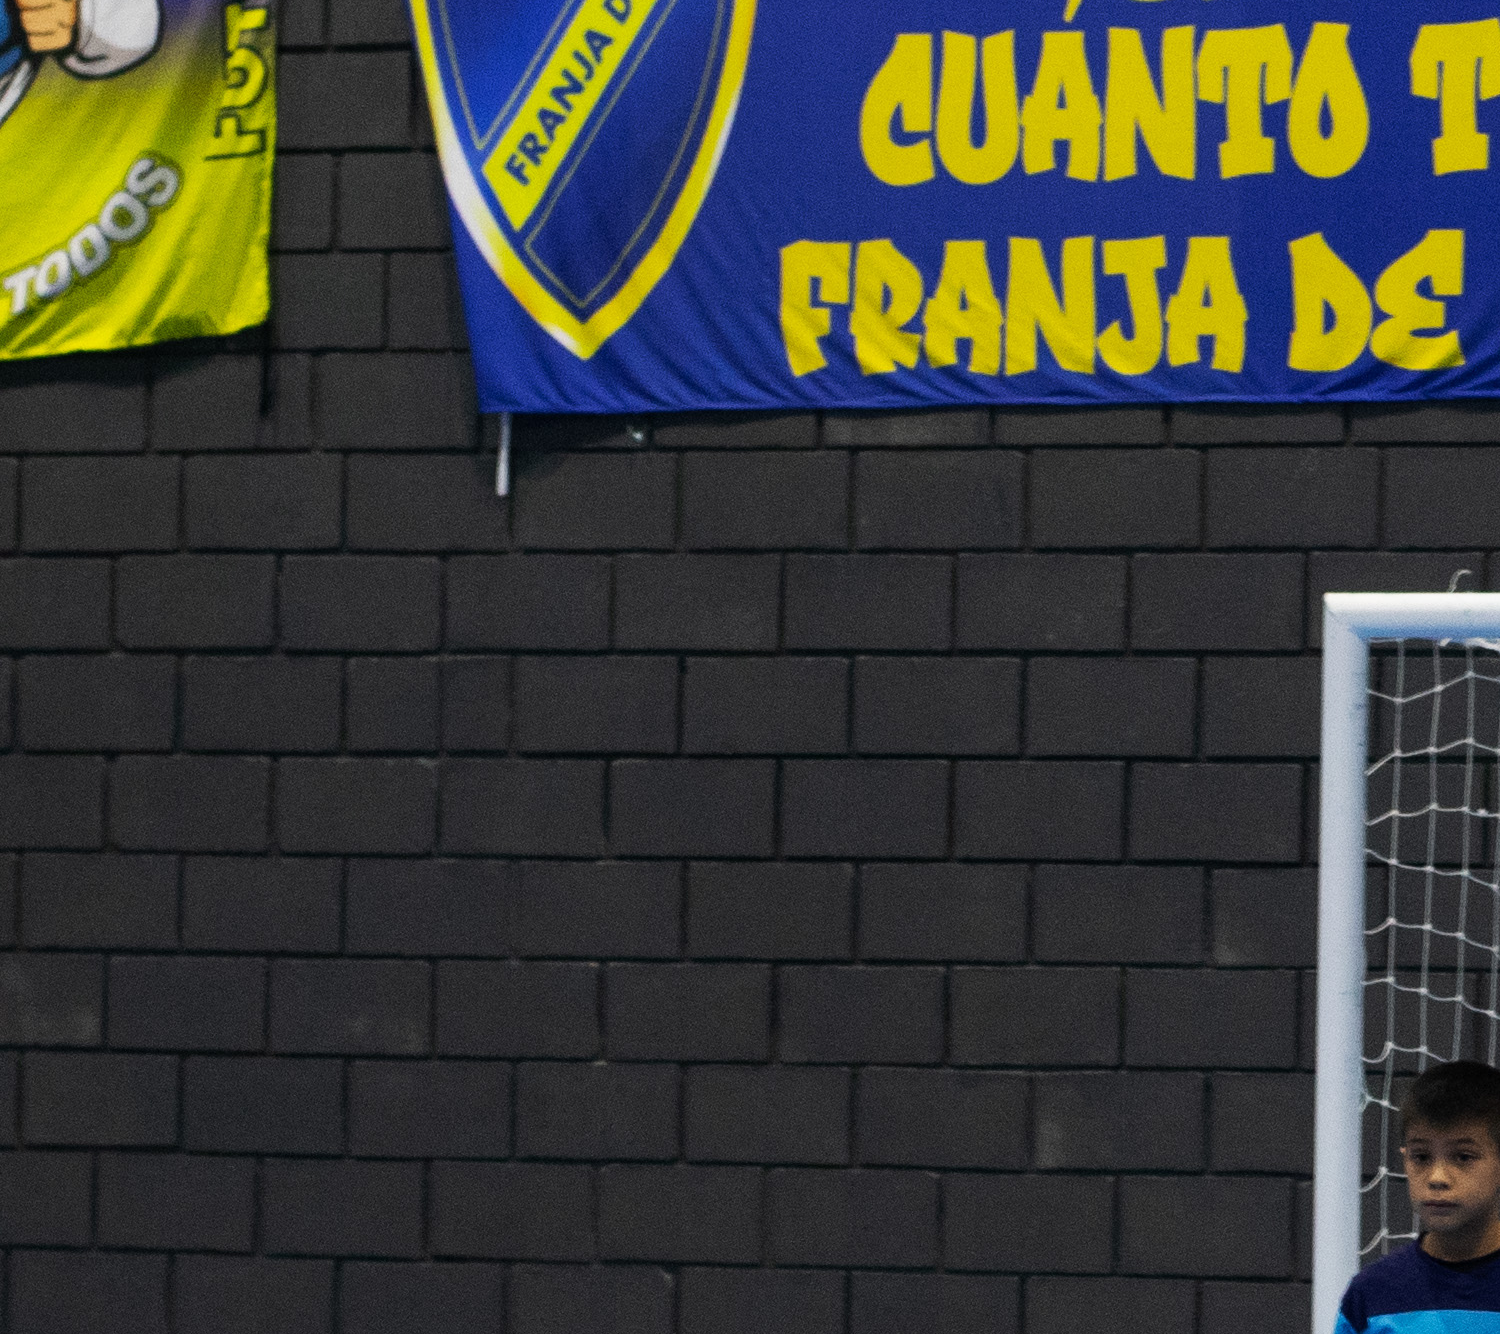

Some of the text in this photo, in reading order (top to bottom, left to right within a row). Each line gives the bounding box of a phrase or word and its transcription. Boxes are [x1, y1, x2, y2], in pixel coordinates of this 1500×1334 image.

[503, 28, 615, 187] FRANJA
[2, 154, 184, 317] TODOS
[780, 235, 1248, 377] FRANJA
[1288, 228, 1466, 372] DE
